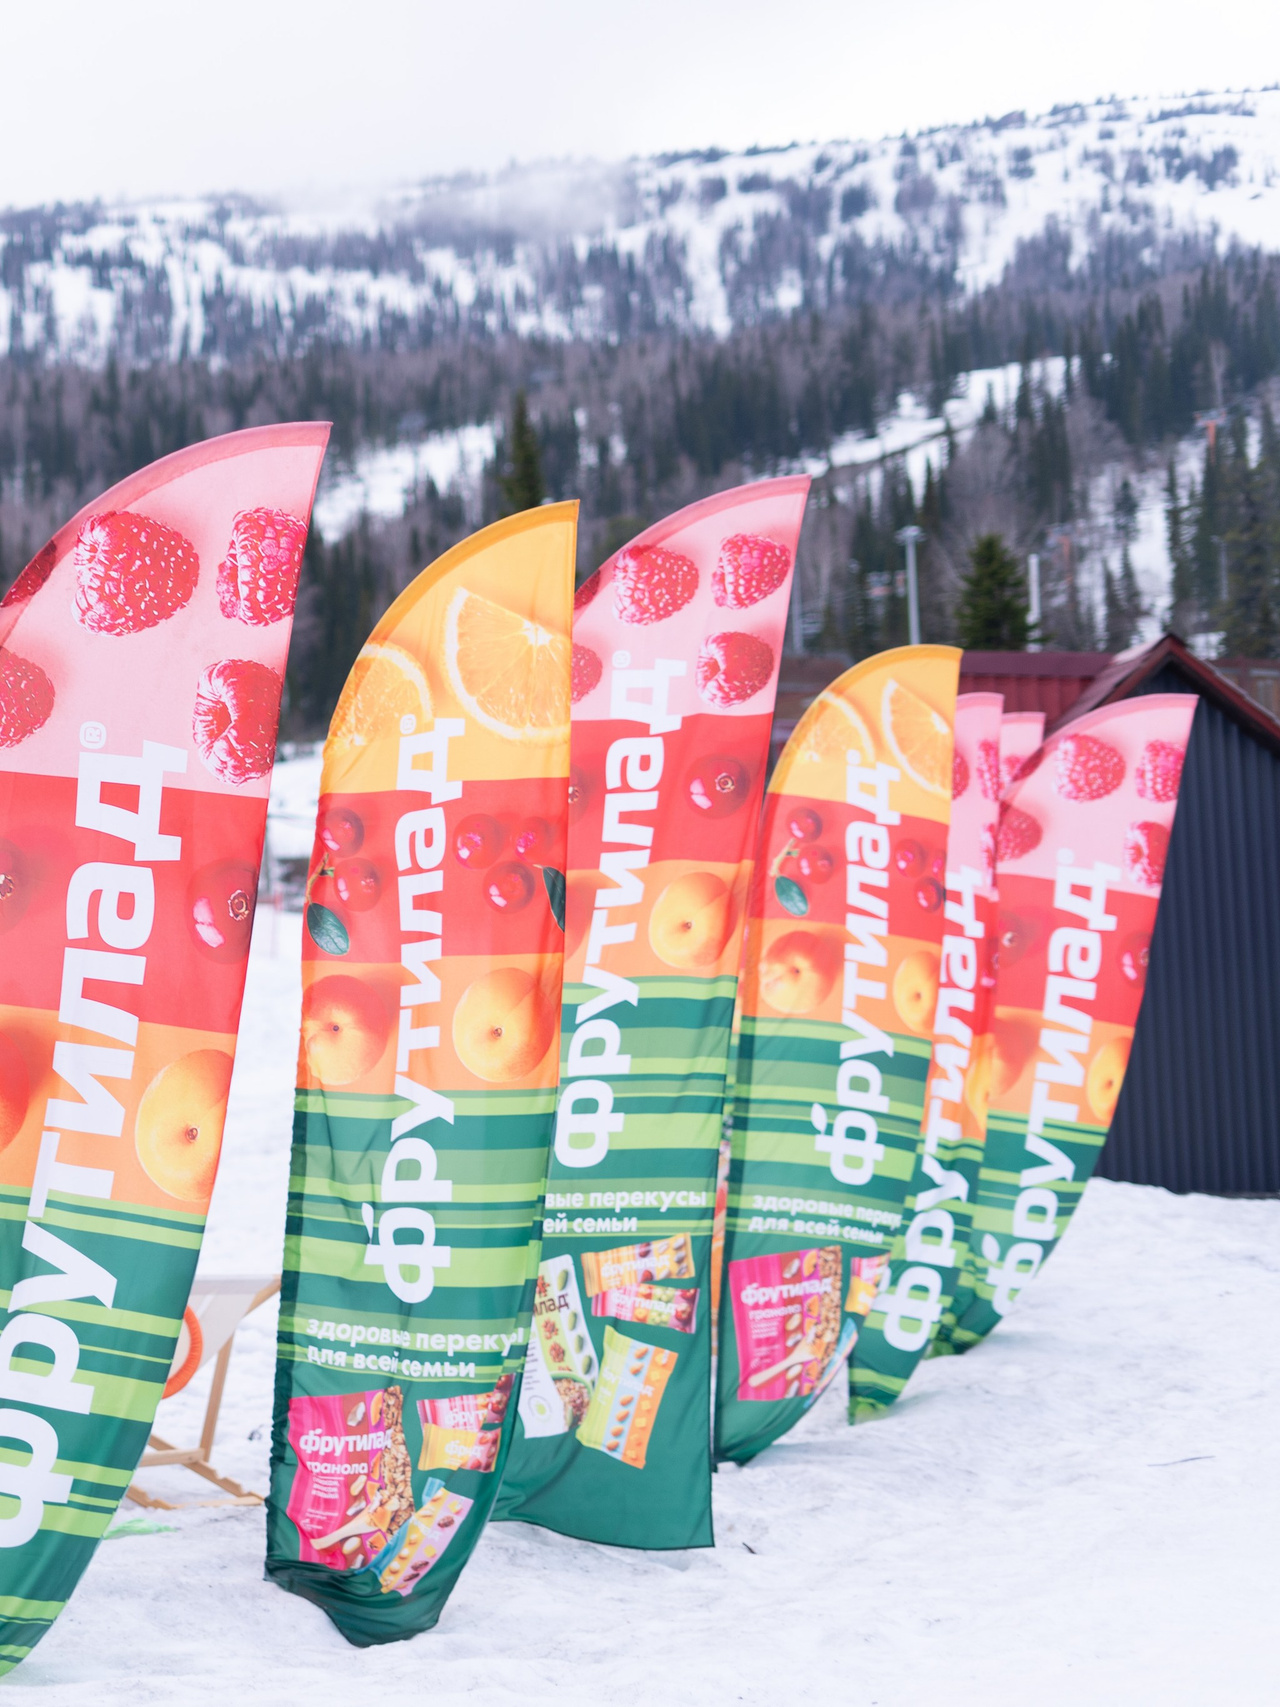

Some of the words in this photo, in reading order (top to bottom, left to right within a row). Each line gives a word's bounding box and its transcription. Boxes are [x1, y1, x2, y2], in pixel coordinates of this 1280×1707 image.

[589, 1191, 707, 1213] перекусы
[751, 1194, 853, 1218] здоровые
[573, 1217, 638, 1233] семьи
[748, 1216, 789, 1232] для
[793, 1219, 840, 1237] всей
[843, 1225, 885, 1244] семьи
[307, 1345, 347, 1368] для
[353, 1350, 400, 1374] всей
[402, 1358, 476, 1378] семьи
